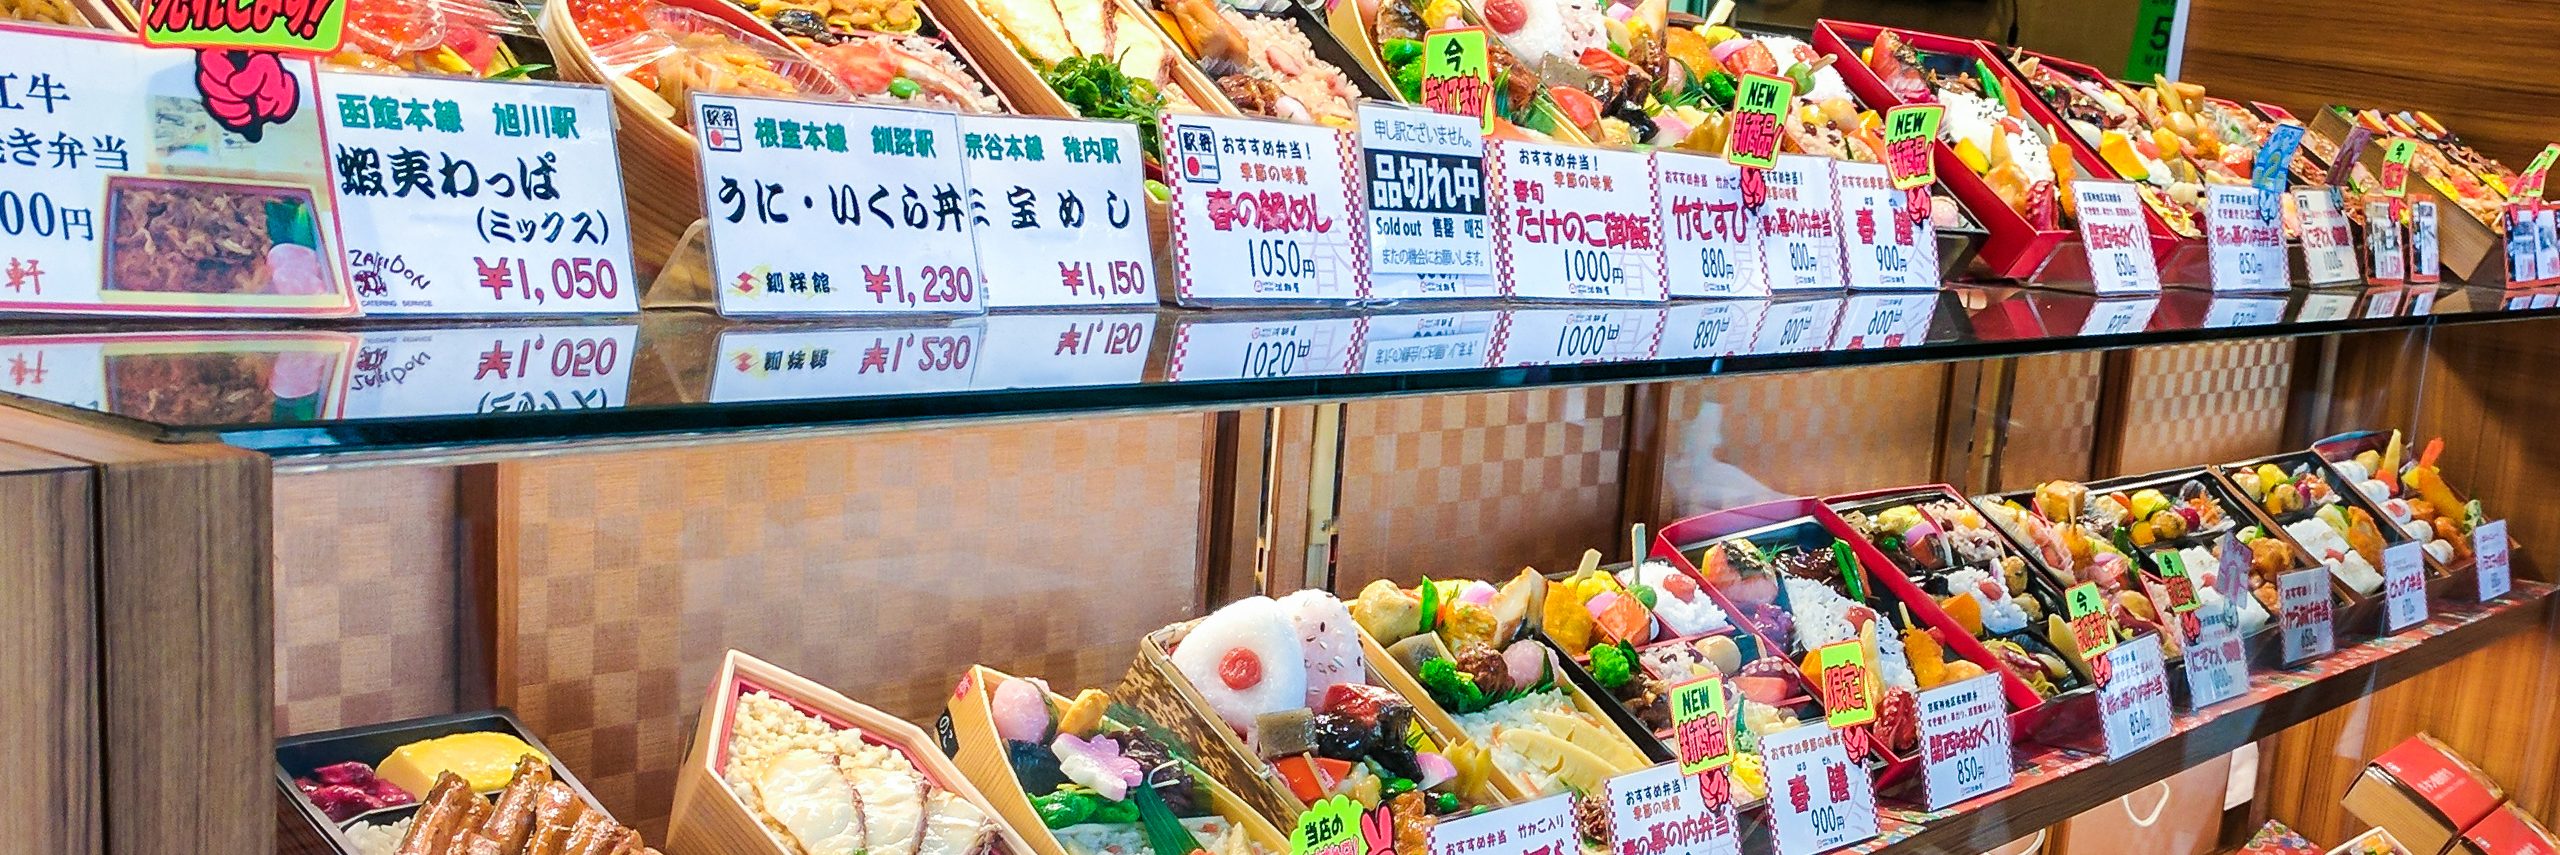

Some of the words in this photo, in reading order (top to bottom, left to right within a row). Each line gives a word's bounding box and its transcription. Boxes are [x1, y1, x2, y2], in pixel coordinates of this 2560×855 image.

[1444, 38, 1464, 72] 今
[1746, 82, 1778, 108] NEW
[336, 94, 464, 133] 函館本線
[492, 102, 580, 139] 旭川駅
[1895, 111, 1927, 136] NEW
[0, 128, 129, 171] き弁当
[754, 117, 849, 152] 根室本線
[870, 125, 937, 158] 釧路駅
[965, 132, 1045, 161] 宗谷本線
[1062, 135, 1121, 164] 稚内駅
[1222, 136, 1311, 160] おすすめ弁当！
[336, 143, 561, 201] 蝦夷わっぱ
[1240, 162, 1309, 185] 季節の味覚
[1519, 149, 1598, 170] おすすめ弁当！
[1373, 153, 1480, 212] 品切れ中
[1553, 171, 1614, 192] 季節の味覚
[718, 175, 965, 233] うに・いくら丼
[477, 206, 609, 245] （ミックス）
[1377, 217, 1401, 236] Sold
[1403, 220, 1422, 237] out
[1516, 206, 1652, 250] たけのこ御飯
[1855, 206, 1876, 244] 春
[1249, 239, 1315, 278] 1050円
[1382, 249, 1485, 268] またの機会にお願いします。
[1565, 249, 1624, 284] 1000円
[1702, 248, 1734, 279] 880円
[1789, 243, 1817, 272] 800円
[1876, 245, 1907, 272] 900円
[473, 256, 618, 305] ¥1,050
[861, 264, 974, 307] ¥1,230
[1058, 261, 1145, 299] ¥1,150
[1682, 686, 1710, 716] NEW
[1825, 660, 1866, 717] 限定！
[1957, 756, 1985, 785] 850円
[1625, 779, 1688, 806] おすすめ弁当！
[1633, 796, 1681, 821] 季節の味覚
[1788, 774, 1810, 814] 春
[1305, 813, 1344, 848] 当店の
[1446, 829, 1507, 855] おすすめ弁当
[1518, 814, 1564, 840] 竹かご入り
[1811, 806, 1845, 836] 900円
